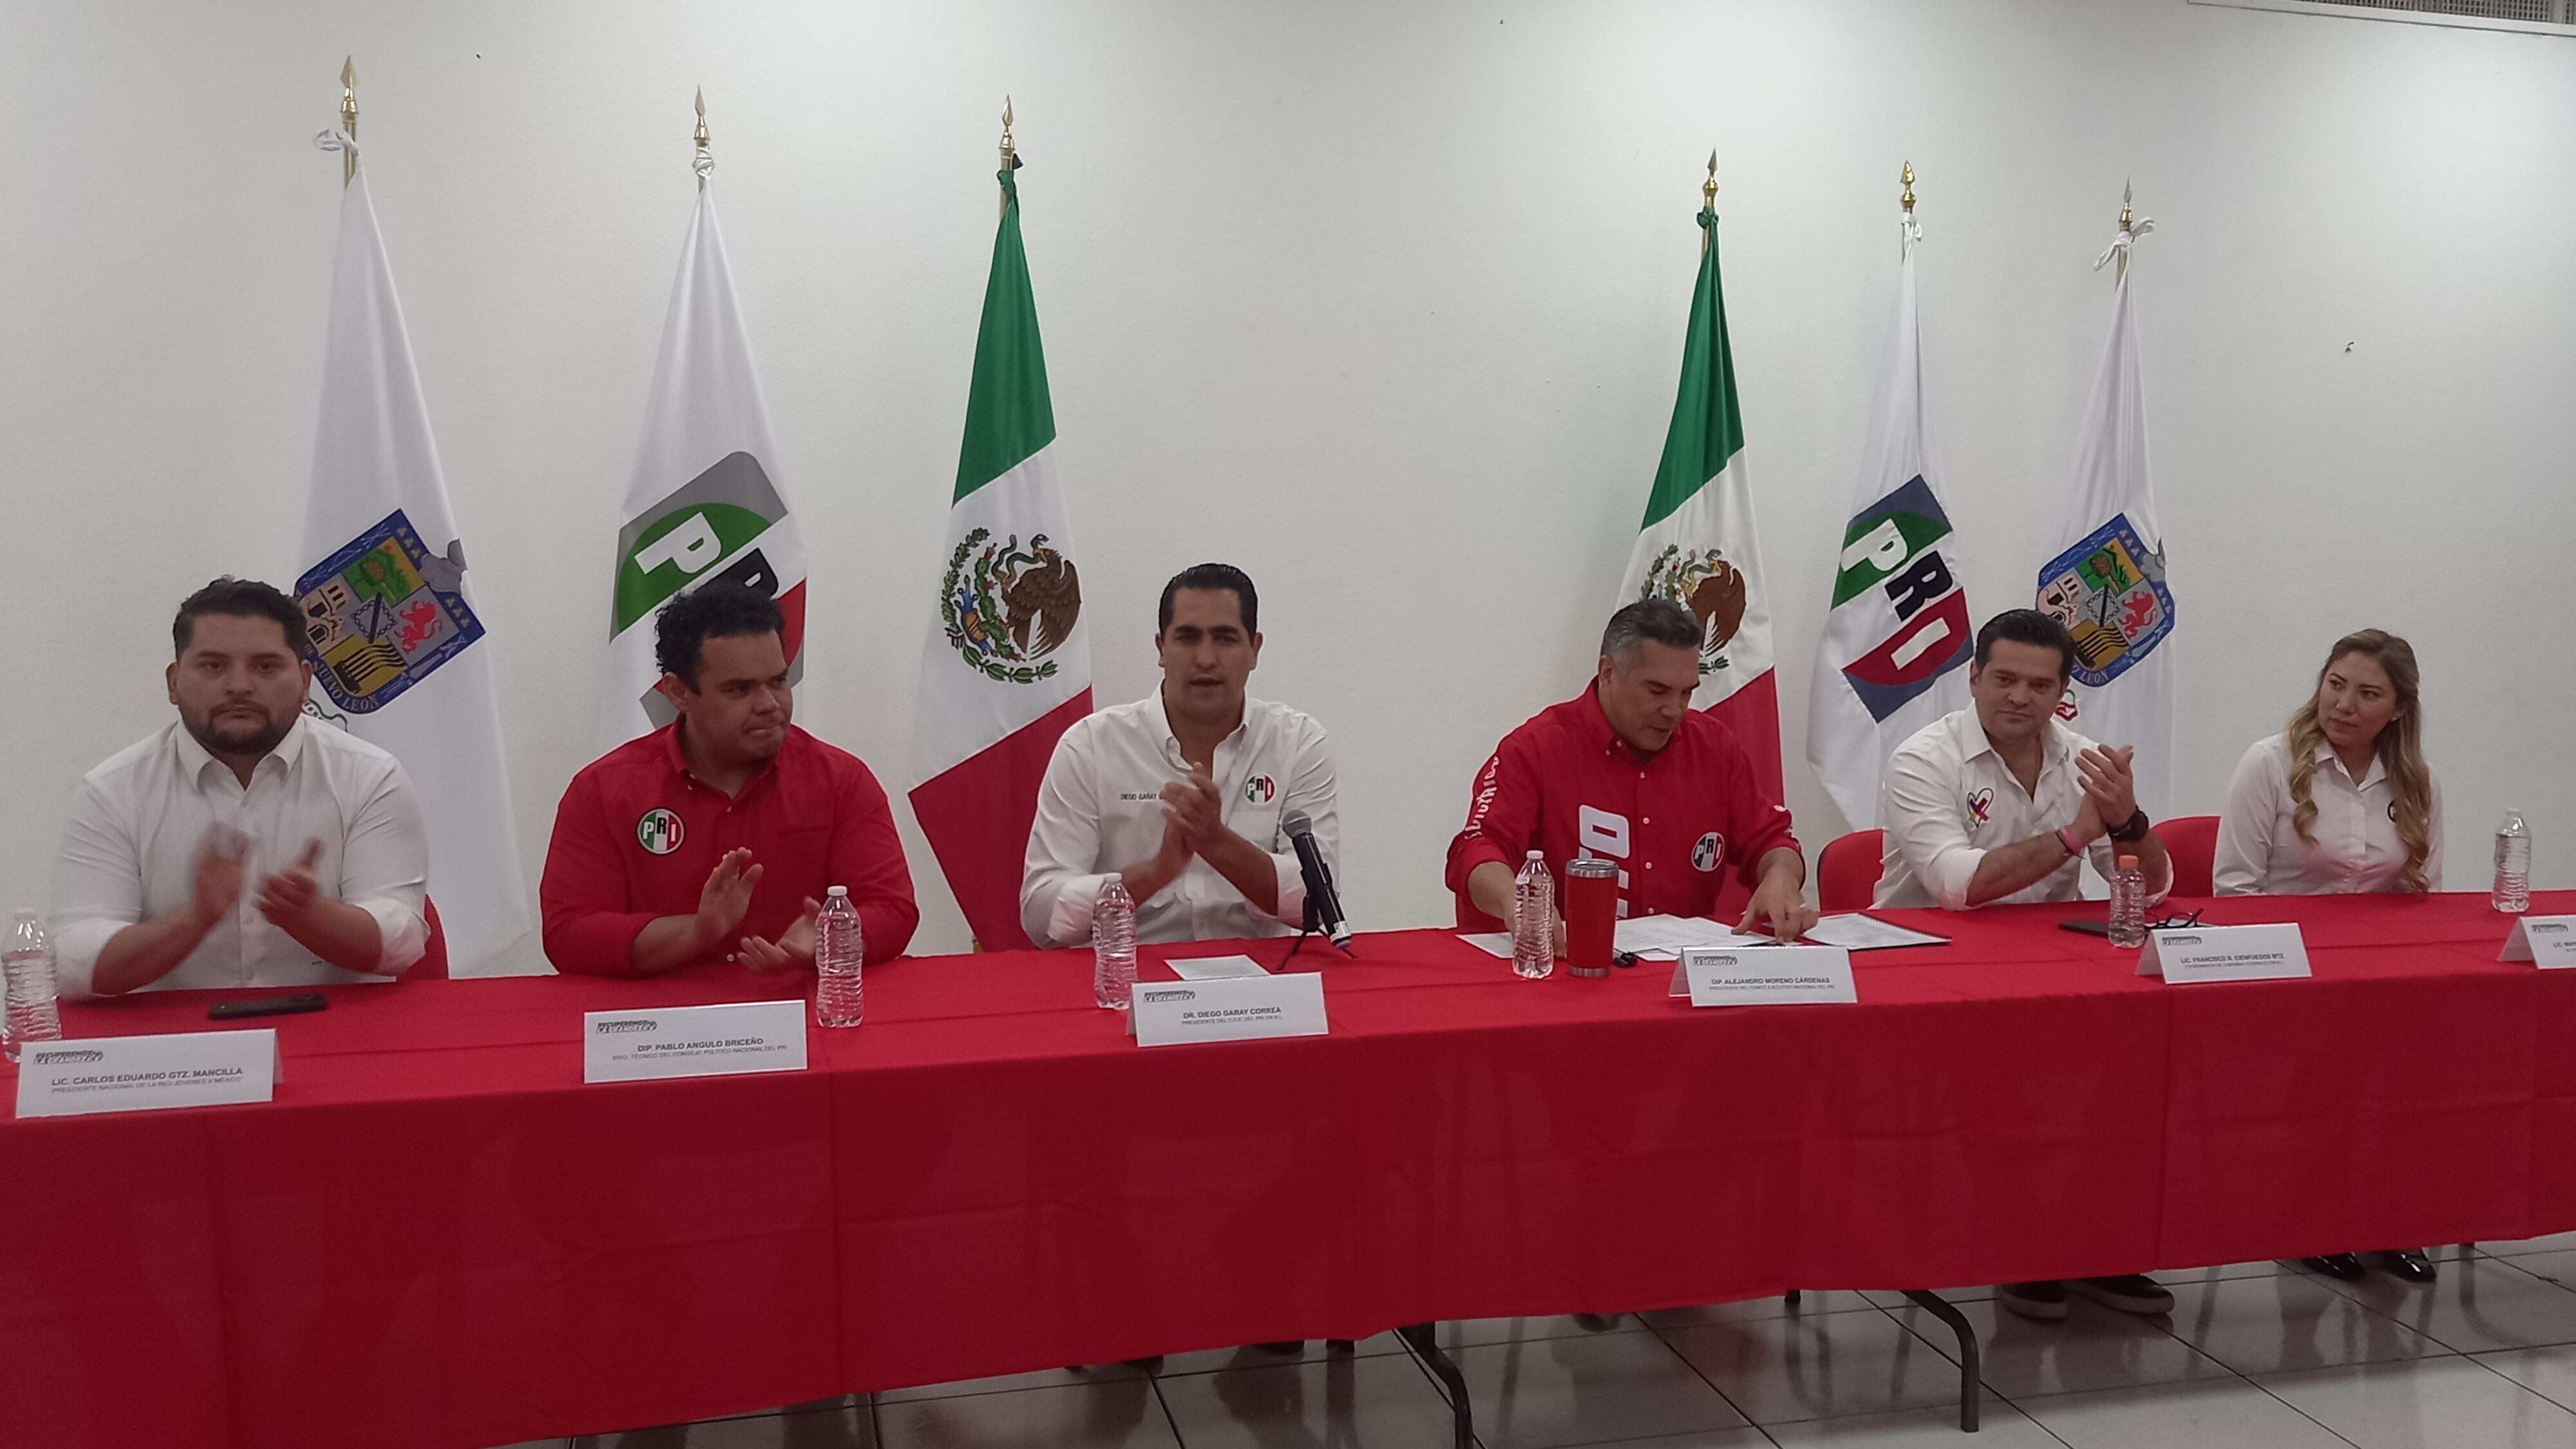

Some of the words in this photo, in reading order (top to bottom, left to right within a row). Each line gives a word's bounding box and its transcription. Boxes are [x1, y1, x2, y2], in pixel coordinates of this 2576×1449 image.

[1840, 518, 1953, 670] PRI
[1247, 779, 1271, 795] PRI
[643, 817, 676, 842] PRI
[1694, 838, 1721, 860] PRI
[1250, 1007, 1281, 1015] CORREA
[686, 1040, 723, 1049] ANGULO
[725, 1037, 764, 1046] BRICEÑO
[73, 1075, 115, 1084] CARLOS
[117, 1072, 166, 1082] EDUARDO
[193, 1068, 242, 1077] MANCILLA
